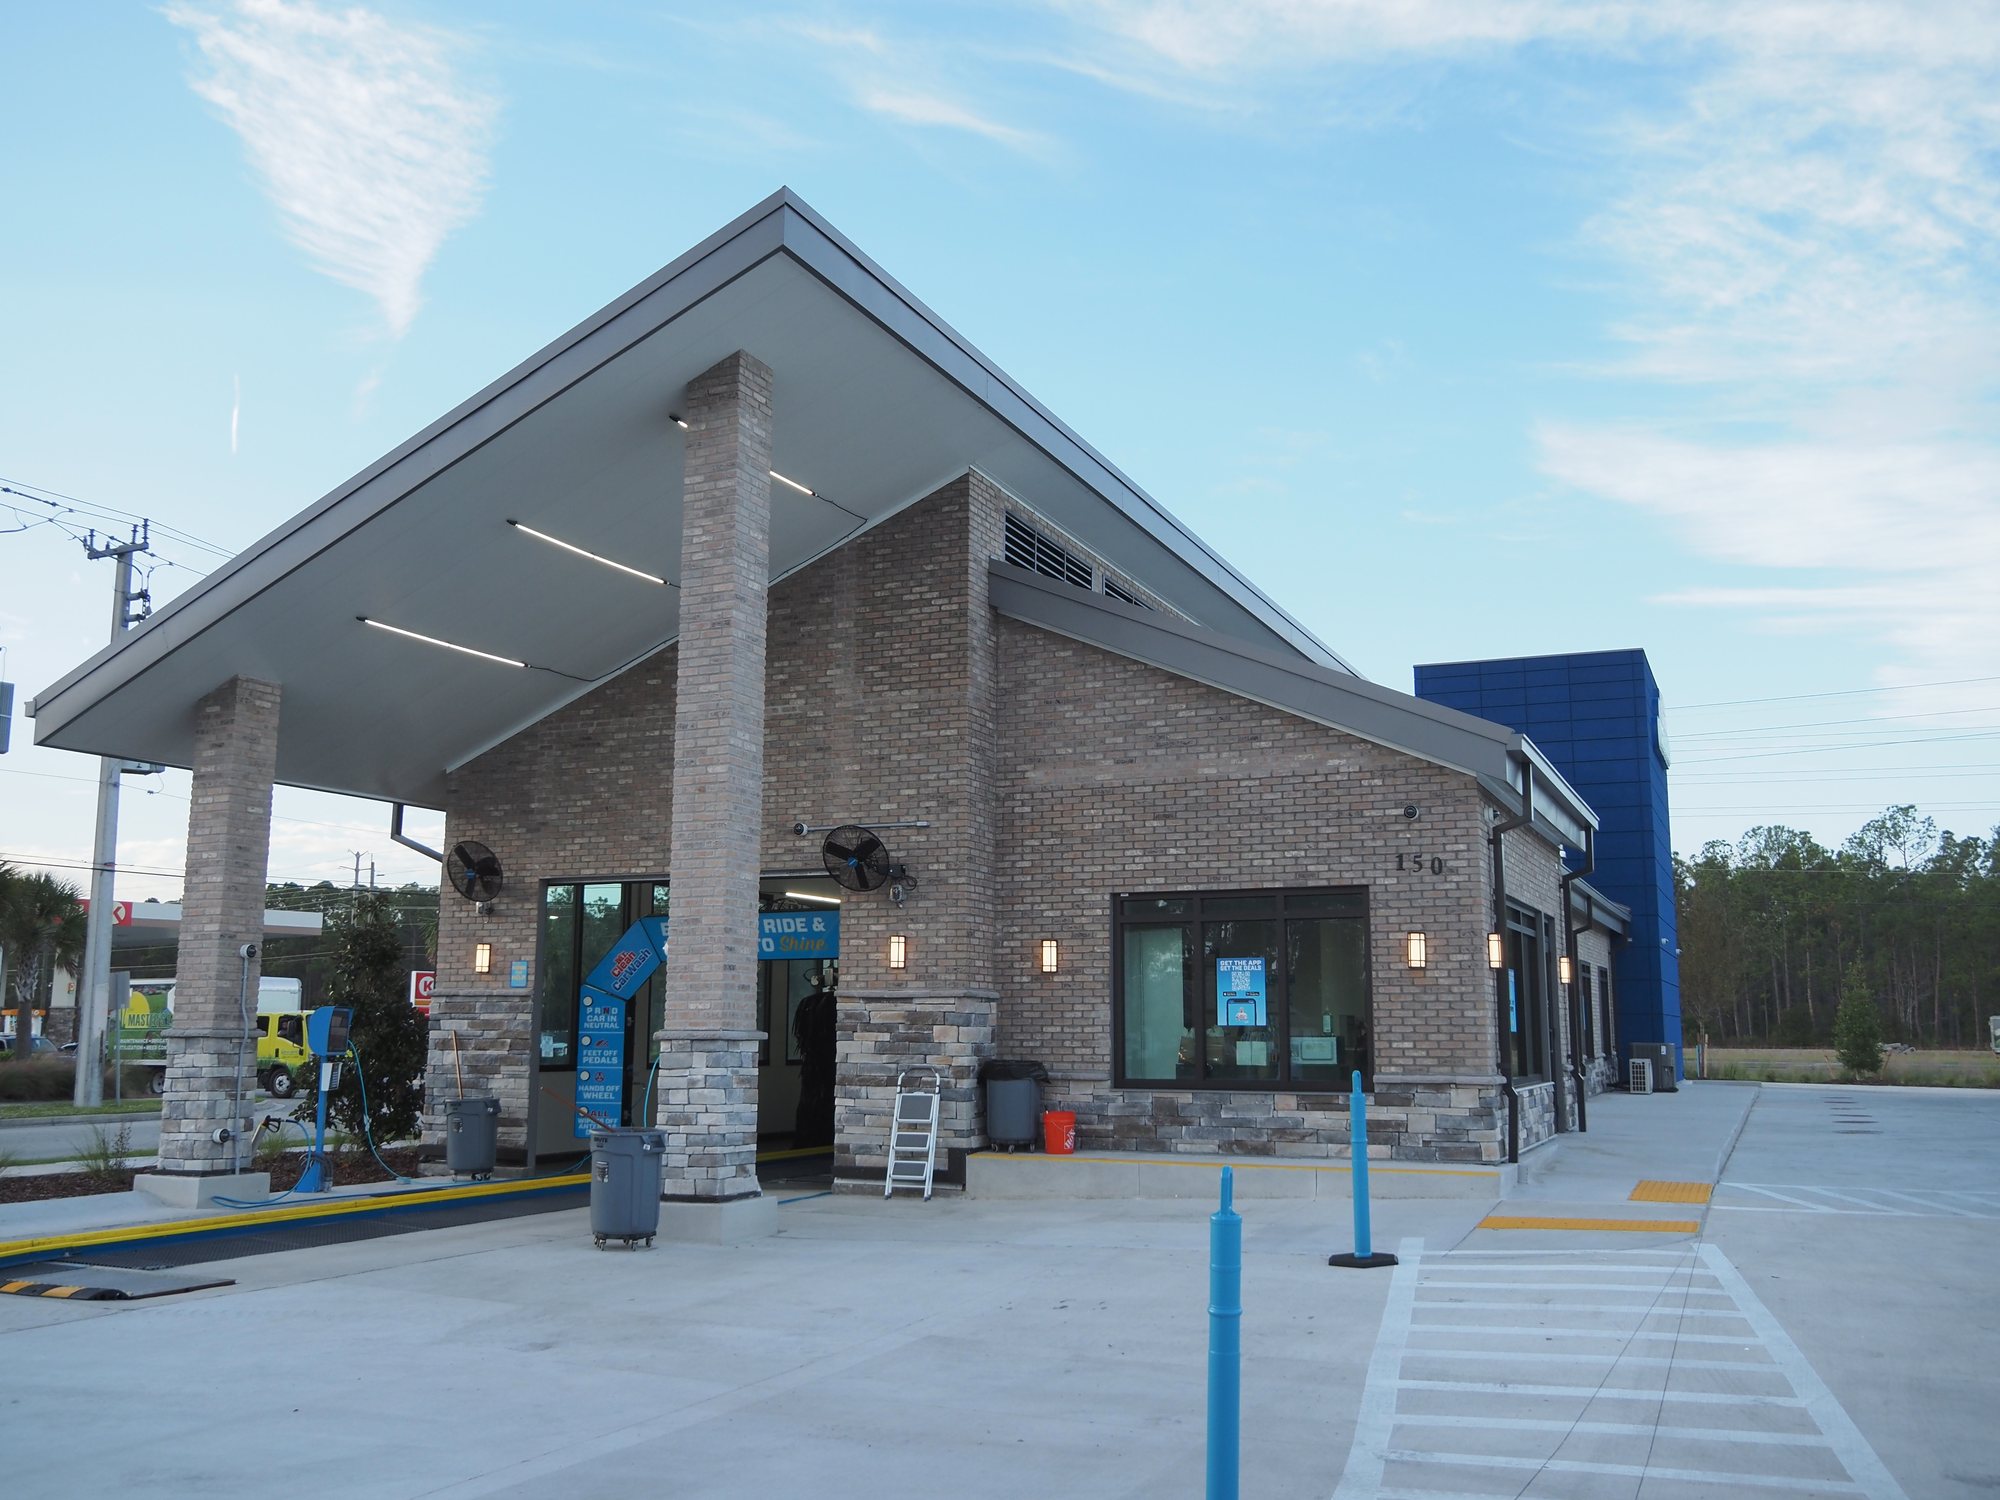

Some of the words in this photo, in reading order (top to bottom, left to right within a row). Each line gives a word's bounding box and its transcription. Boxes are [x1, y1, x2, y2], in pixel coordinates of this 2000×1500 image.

[1396, 852, 1442, 875] 150
[763, 917, 808, 933] RIDE
[812, 916, 826, 932] &
[758, 937, 775, 952] O
[780, 935, 826, 952] Shine
[611, 951, 636, 977] Clean
[423, 980, 433, 992] K
[582, 1056, 618, 1064] PEDALS
